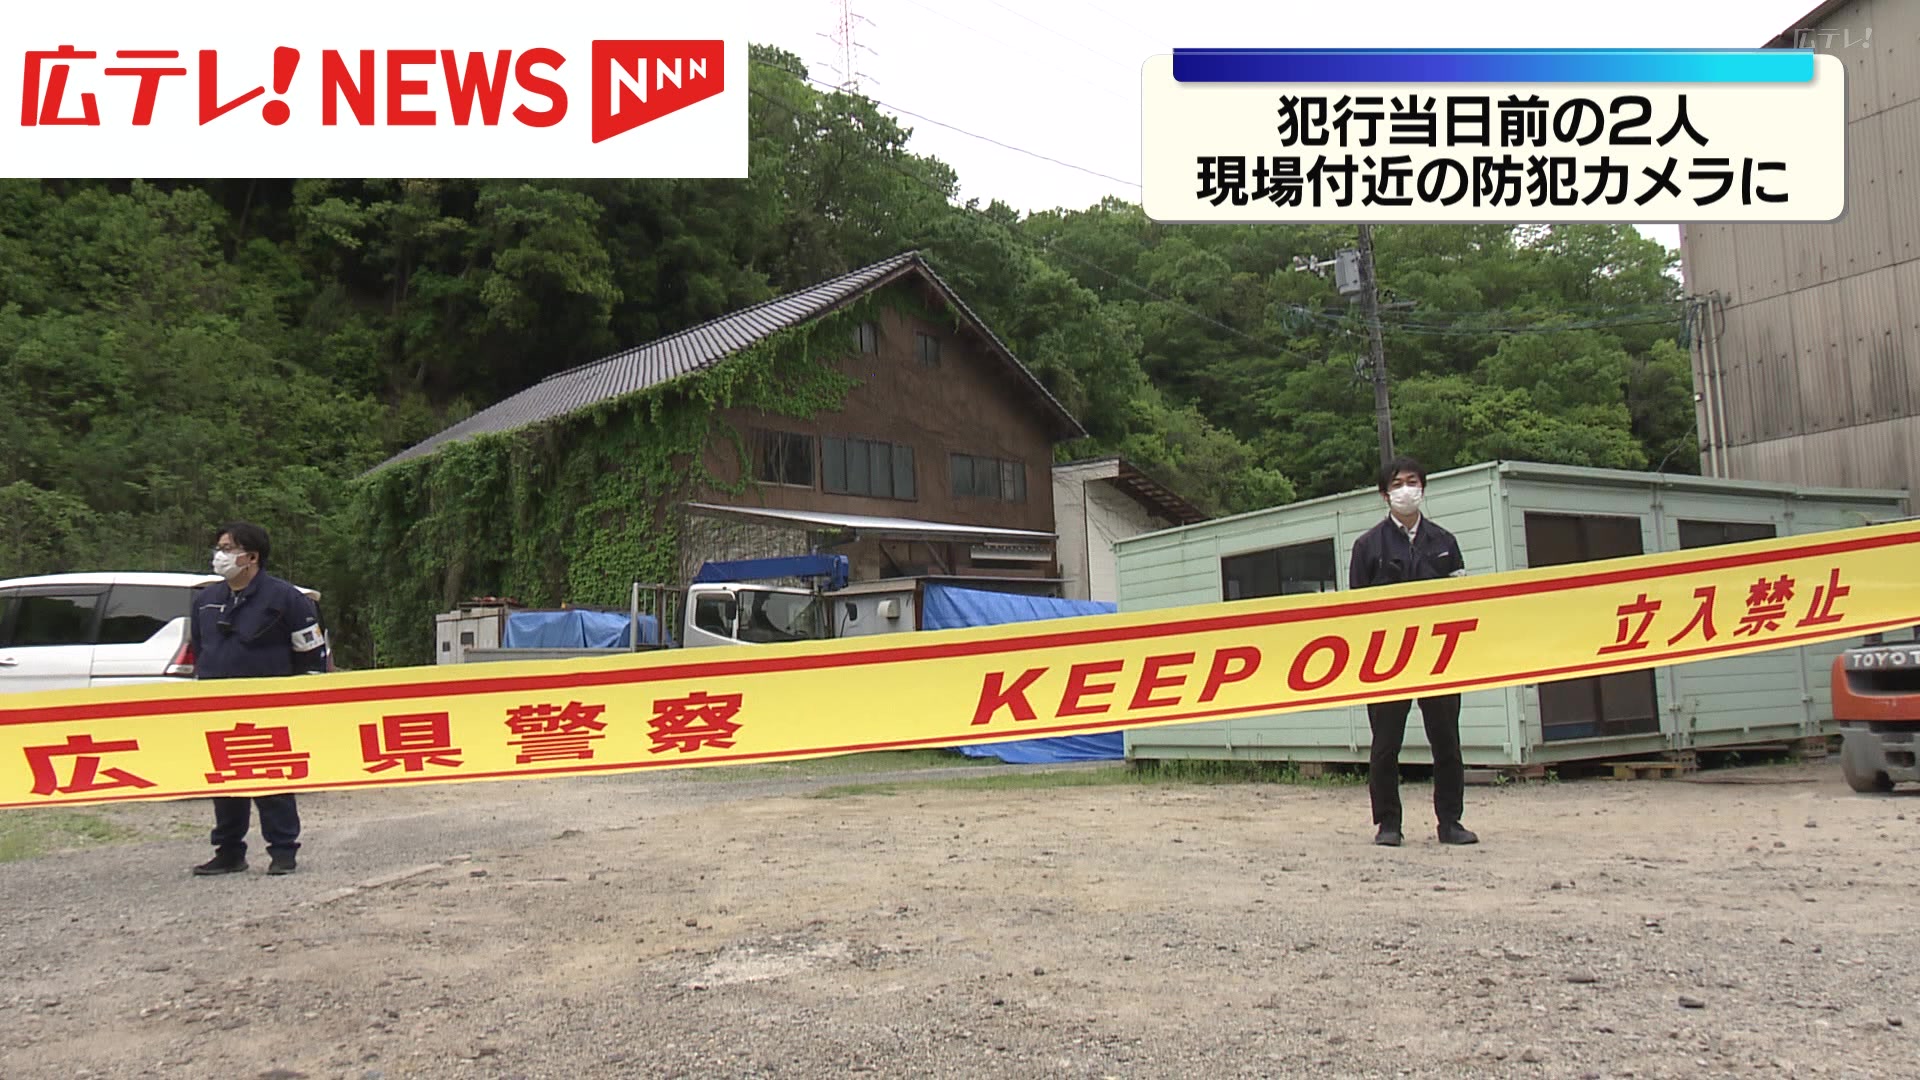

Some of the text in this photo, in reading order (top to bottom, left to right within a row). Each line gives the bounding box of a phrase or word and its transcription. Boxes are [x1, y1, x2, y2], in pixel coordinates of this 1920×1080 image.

[1598, 568, 1851, 655] 立入禁止
[972, 618, 1479, 725] KEEP OUT
[23, 691, 743, 796] 広島県警察
